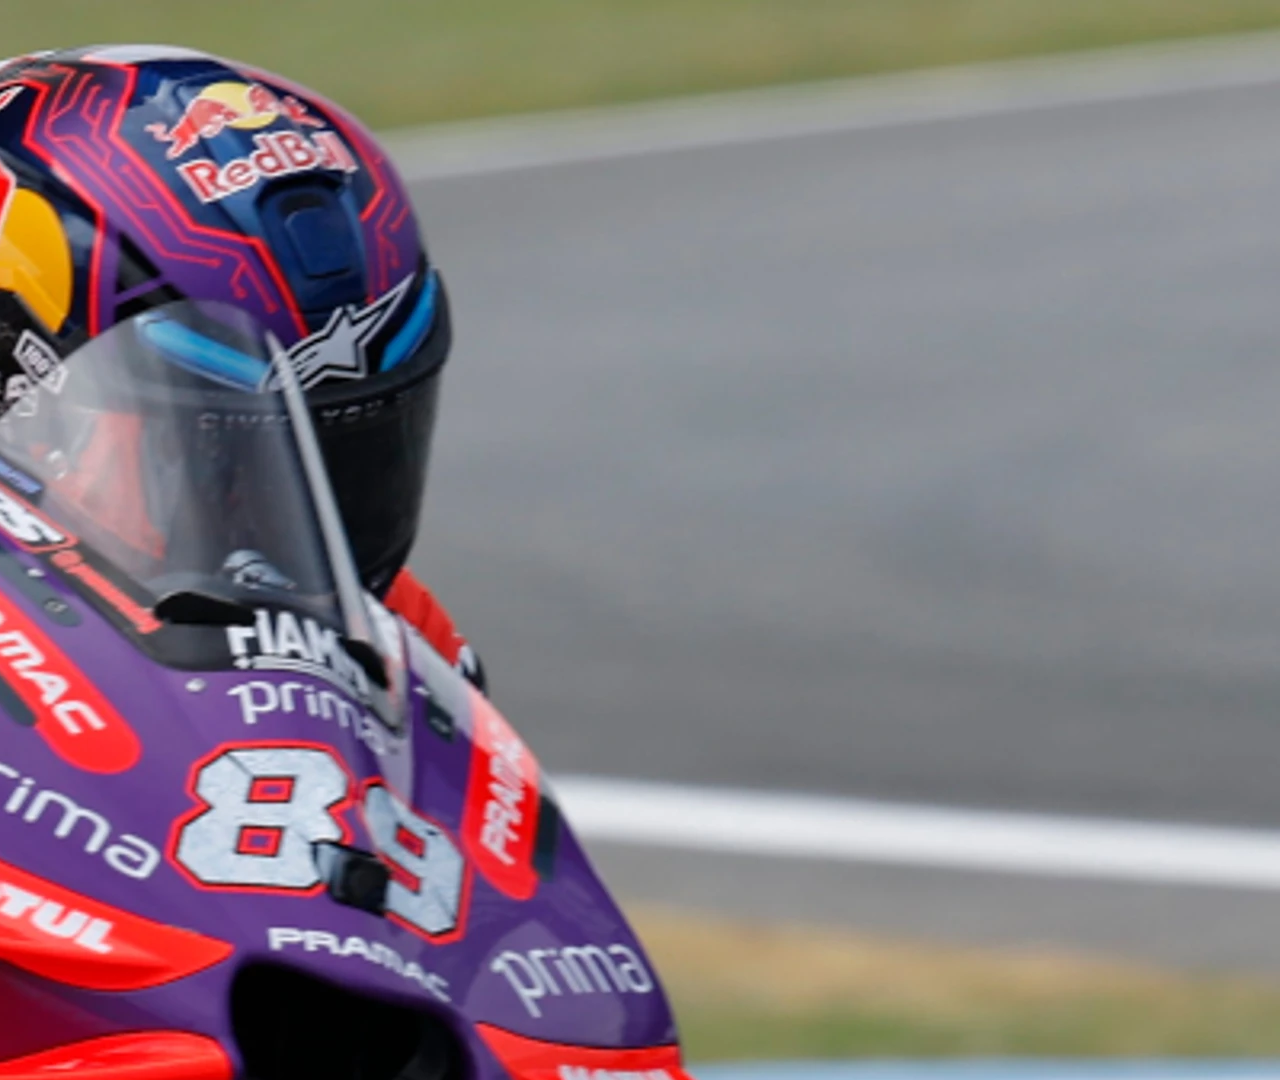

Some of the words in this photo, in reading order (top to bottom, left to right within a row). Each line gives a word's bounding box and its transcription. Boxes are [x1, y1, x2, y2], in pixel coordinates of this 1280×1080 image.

[226, 680, 390, 757] prima
[166, 740, 472, 945] 89
[267, 926, 453, 1003] PRAMAC
[490, 943, 655, 1019] prima
